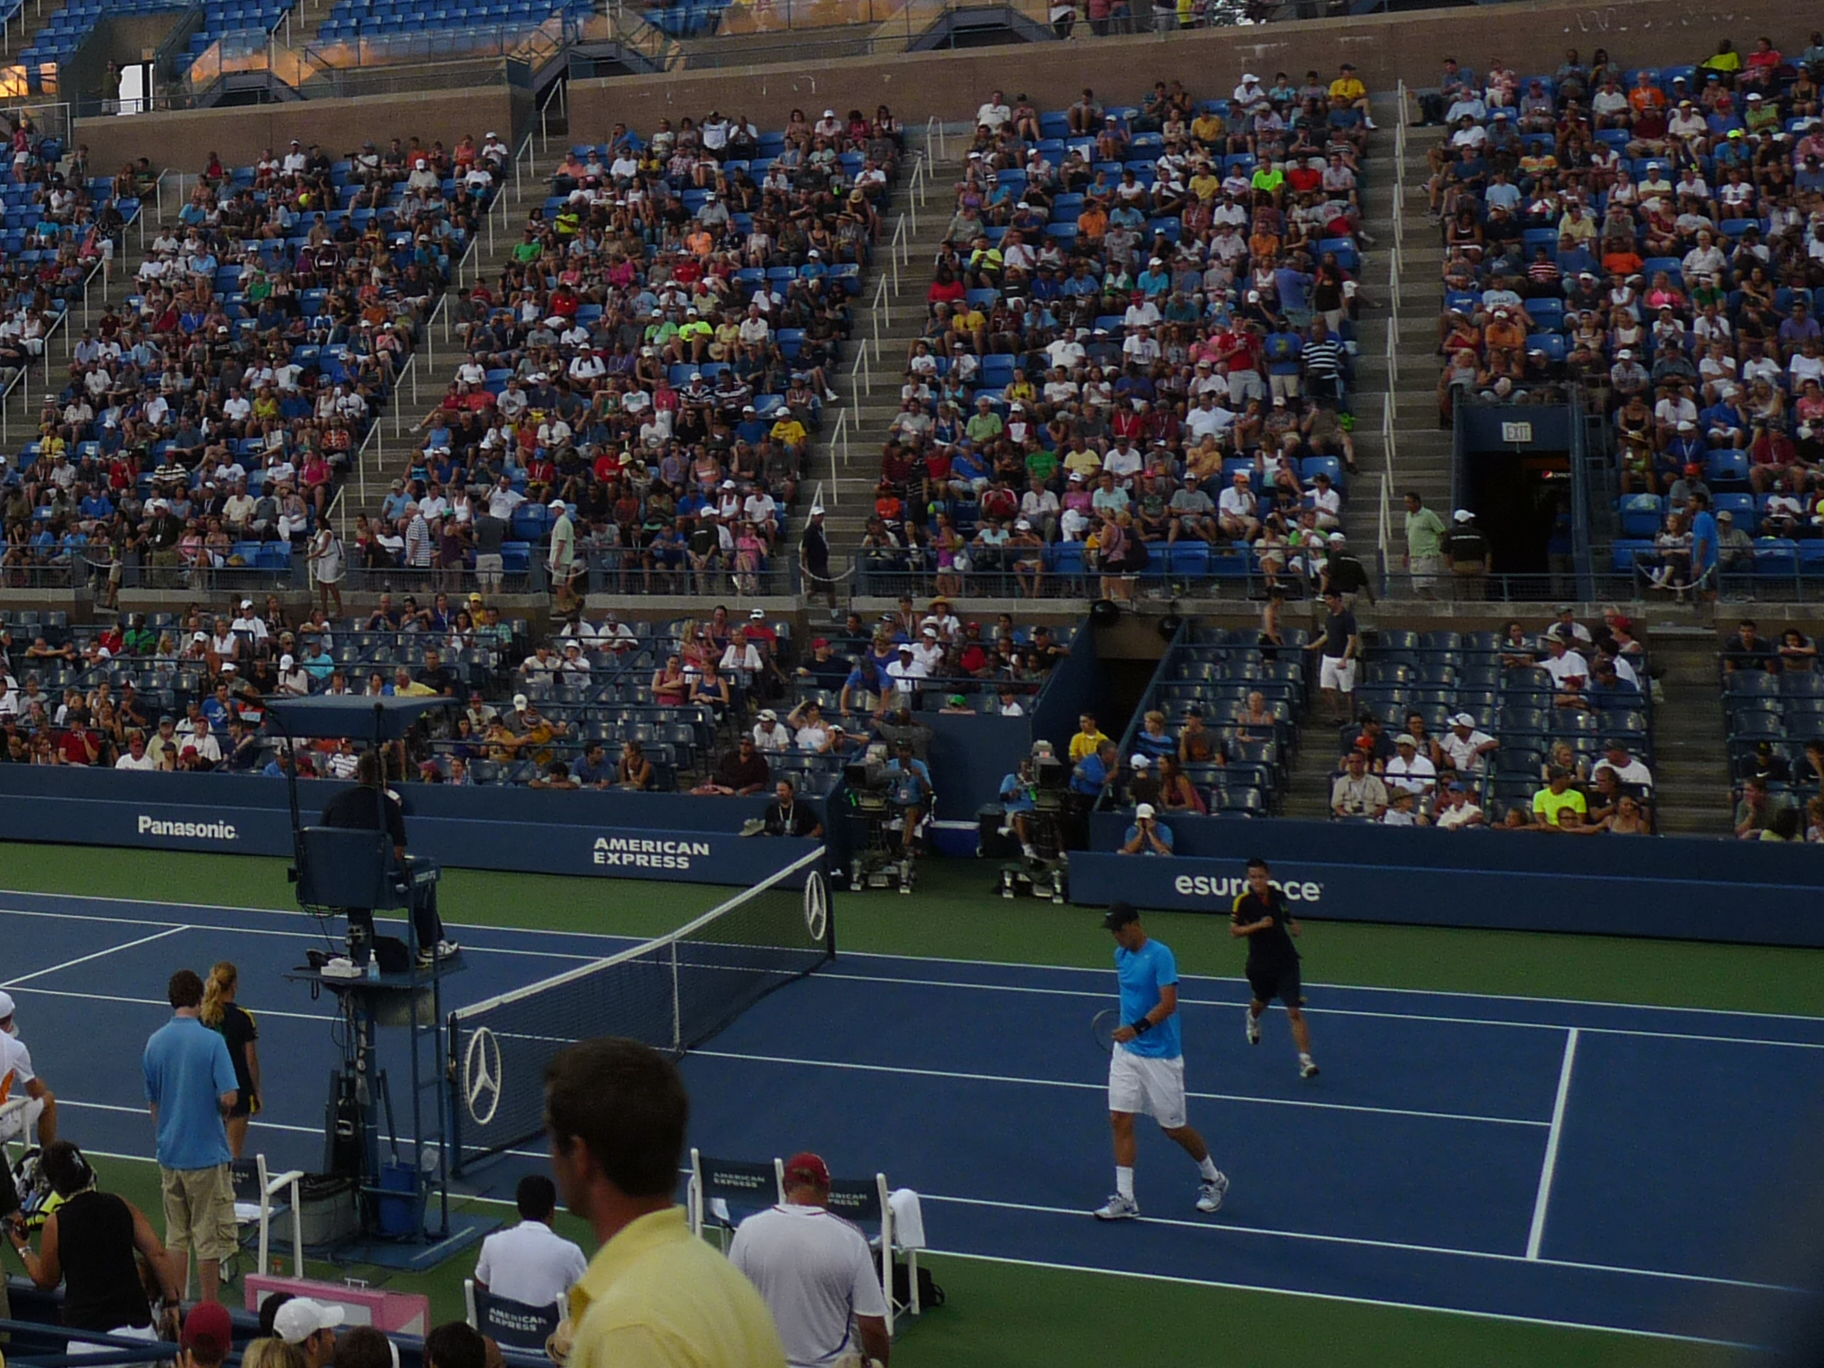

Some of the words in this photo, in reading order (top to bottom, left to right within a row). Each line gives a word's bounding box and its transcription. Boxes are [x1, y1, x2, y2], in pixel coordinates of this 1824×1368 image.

[1506, 425, 1528, 440] EXIT
[137, 815, 237, 840] Panasonic
[593, 837, 710, 856] AMERICAN
[593, 851, 690, 870] EXPRESS
[1174, 875, 1322, 902] esurce
[713, 1172, 765, 1183] AMERICAN
[489, 1314, 537, 1332] EXPRESS
[490, 1307, 547, 1324] AMERICAN
